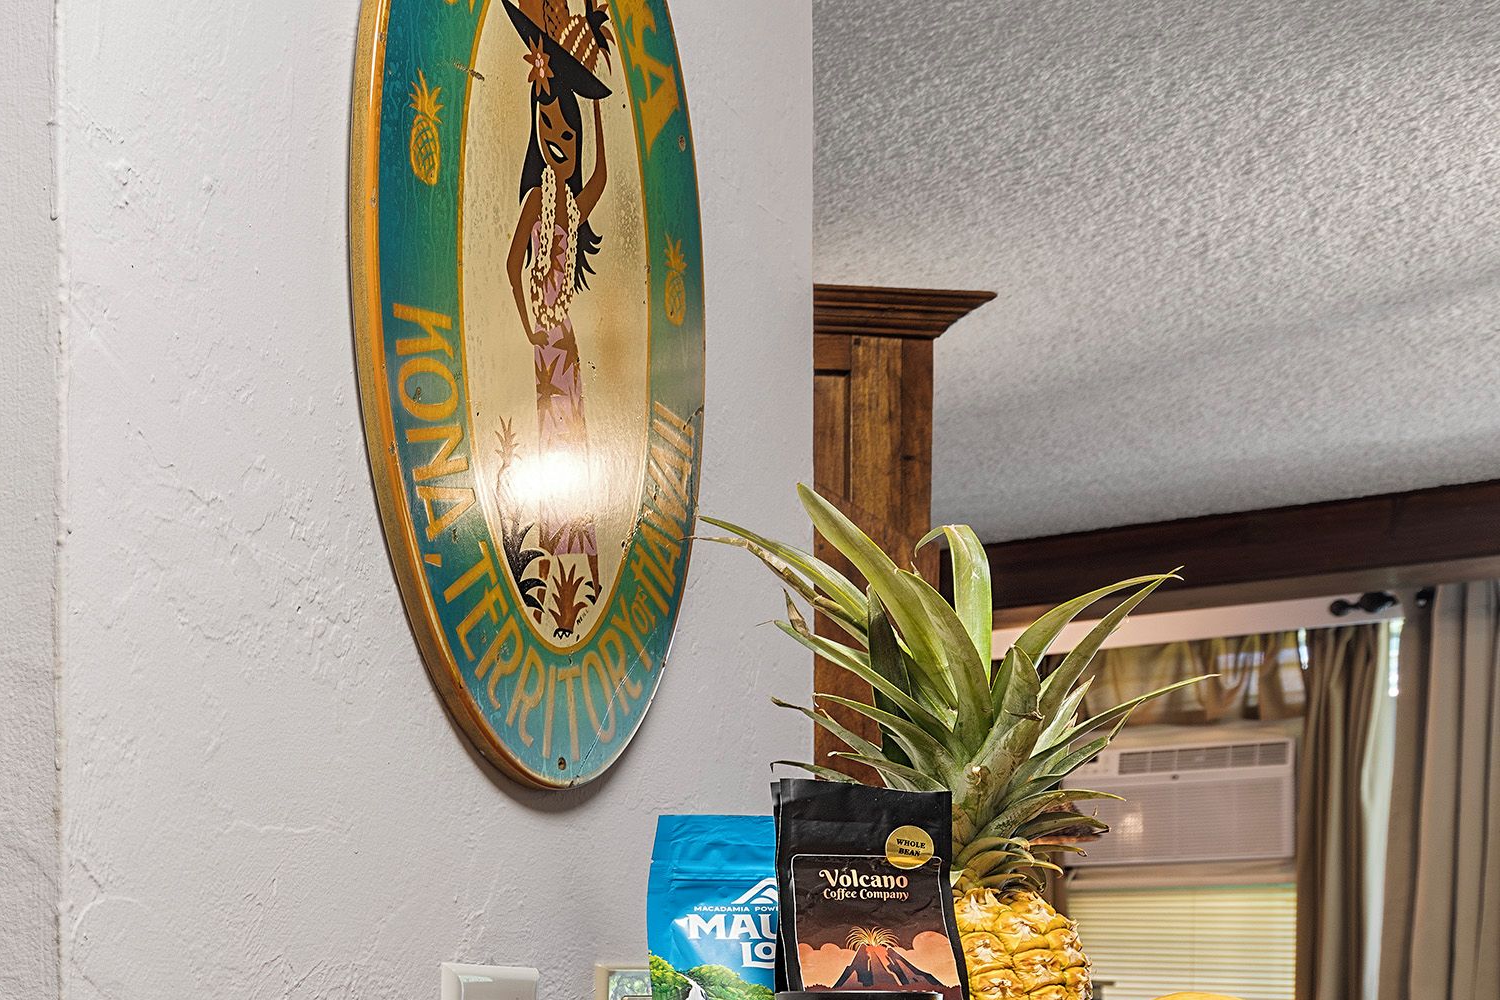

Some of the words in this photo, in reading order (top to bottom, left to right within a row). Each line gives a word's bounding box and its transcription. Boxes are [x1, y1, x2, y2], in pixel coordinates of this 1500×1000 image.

[443, 540, 653, 760] TERRITORY
[630, 400, 695, 618] HAWAII
[896, 838, 926, 849] WHOLE
[898, 848, 921, 857] BEAN
[818, 868, 909, 890] Volcano
[823, 887, 858, 902] Coffee
[859, 888, 910, 902] Company
